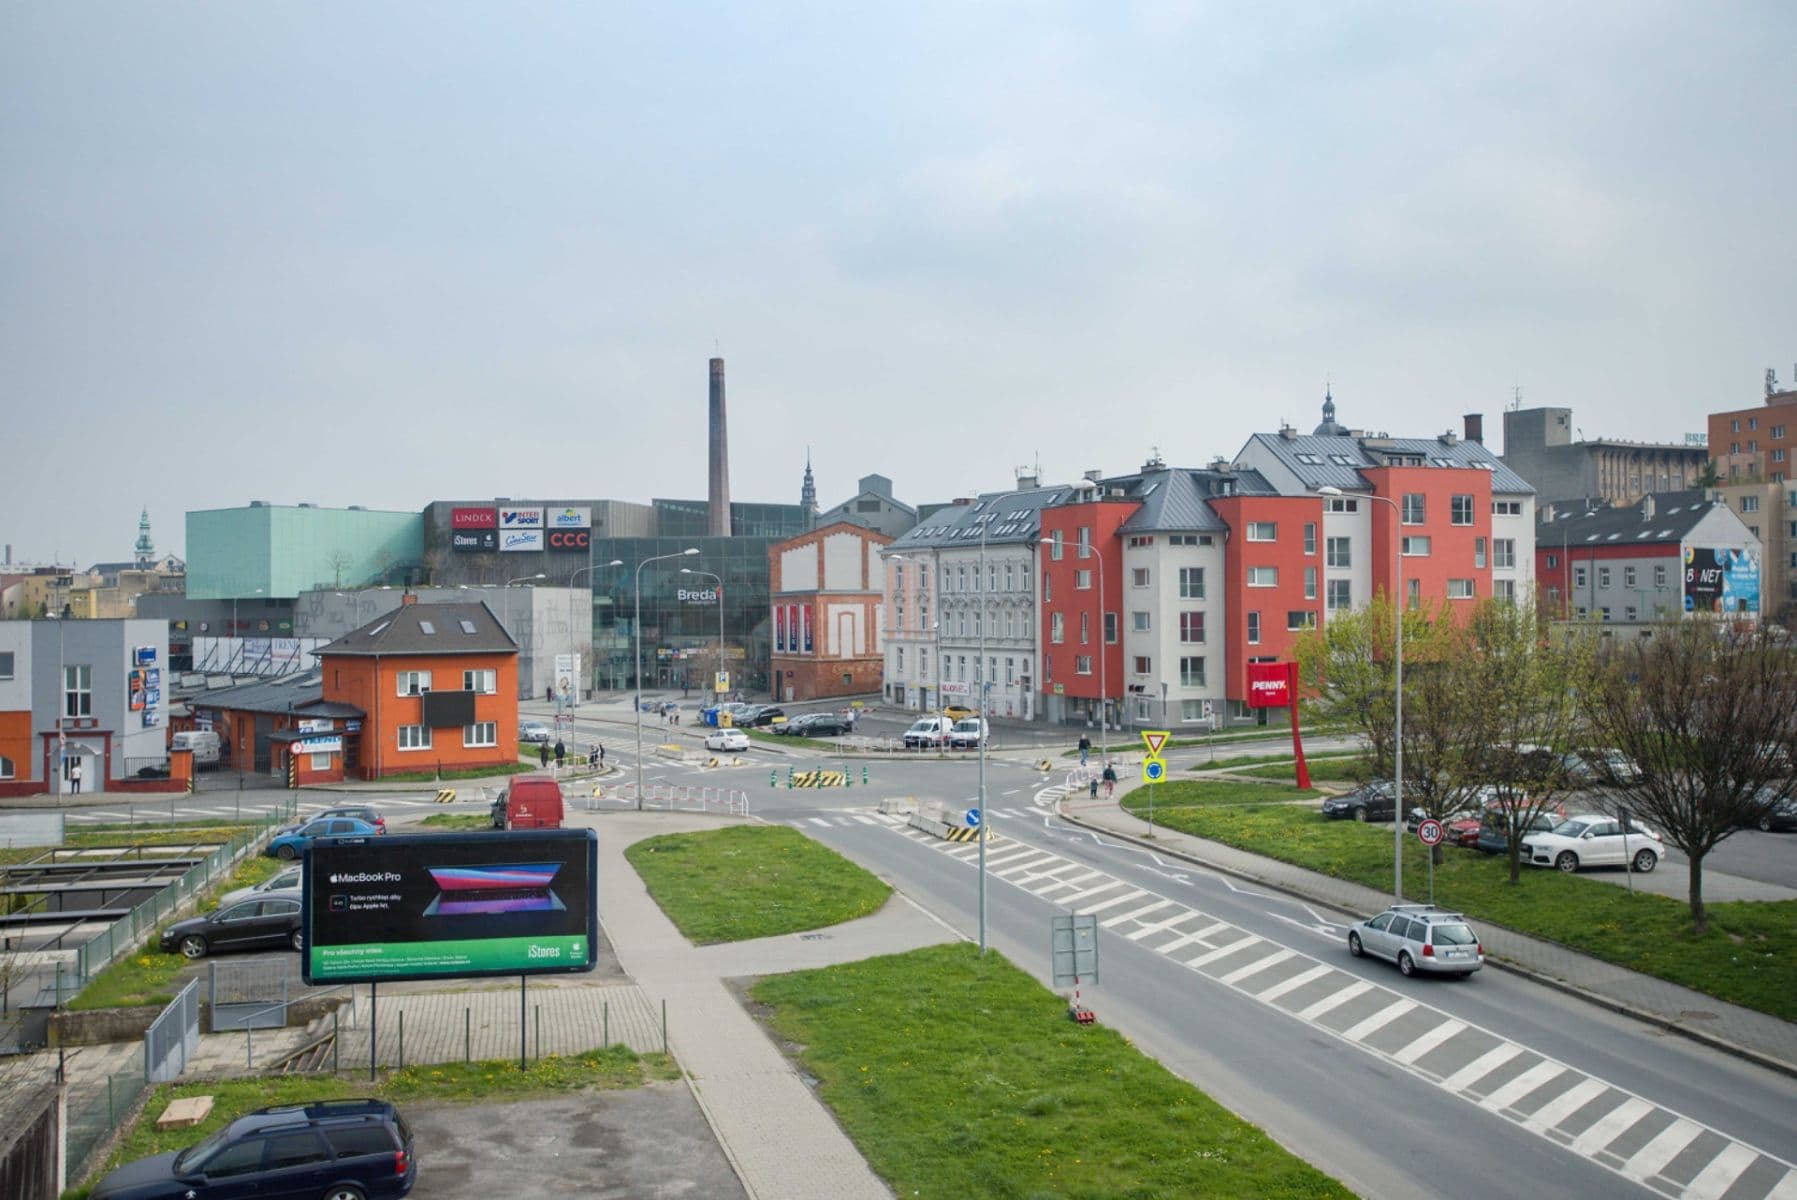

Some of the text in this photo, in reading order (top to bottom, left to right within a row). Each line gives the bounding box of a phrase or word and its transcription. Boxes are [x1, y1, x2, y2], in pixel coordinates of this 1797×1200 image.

[455, 513, 492, 522] LINDEX
[557, 512, 581, 522] albert
[550, 532, 588, 547] CCC
[677, 588, 716, 600] Breda
[1423, 826, 1438, 838] 30
[338, 872, 401, 883] MacBook Pro
[528, 945, 560, 959] iStores
